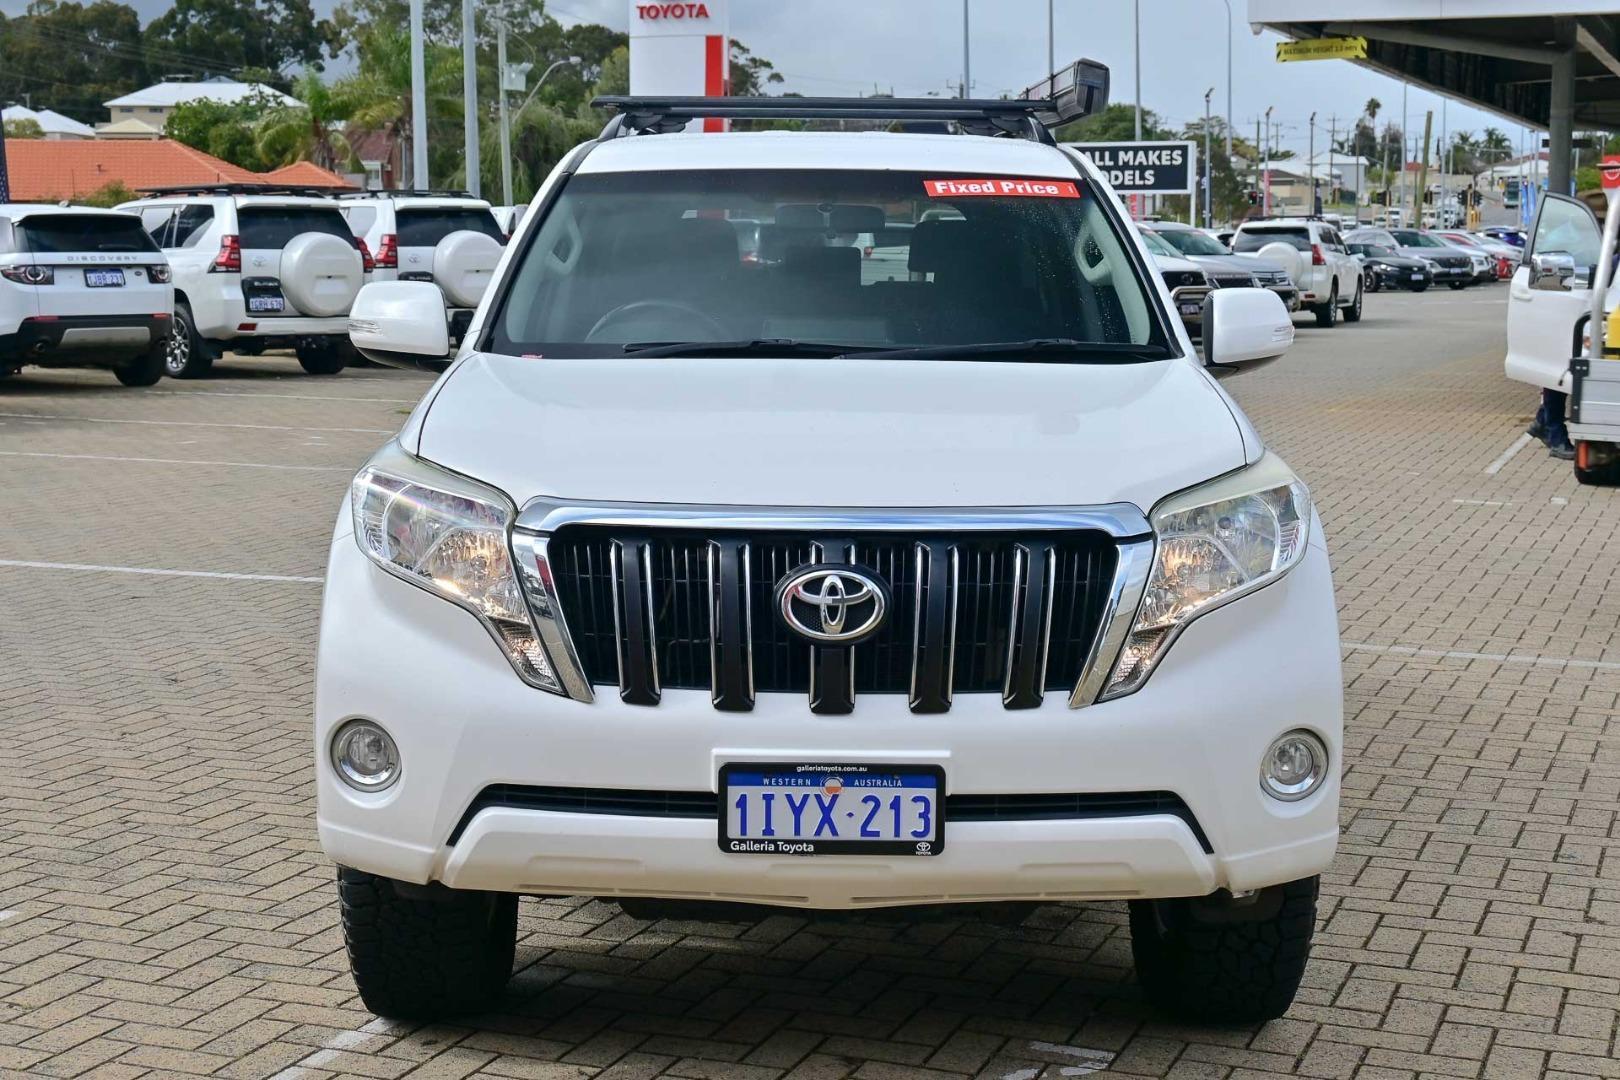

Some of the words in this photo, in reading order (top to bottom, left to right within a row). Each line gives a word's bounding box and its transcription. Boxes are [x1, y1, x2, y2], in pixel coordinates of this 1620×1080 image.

[636, 4, 709, 19] TOYOTA
[1118, 150, 1182, 166] MAKES
[934, 181, 997, 194] Fixed
[1000, 181, 1060, 195] Price
[796, 765, 868, 773] galleriatoyota.com.au
[763, 778, 811, 786] WESTERN
[854, 780, 902, 788] AUSTRALIA
[730, 841, 775, 852] Galleria
[777, 841, 815, 853] Toyota
